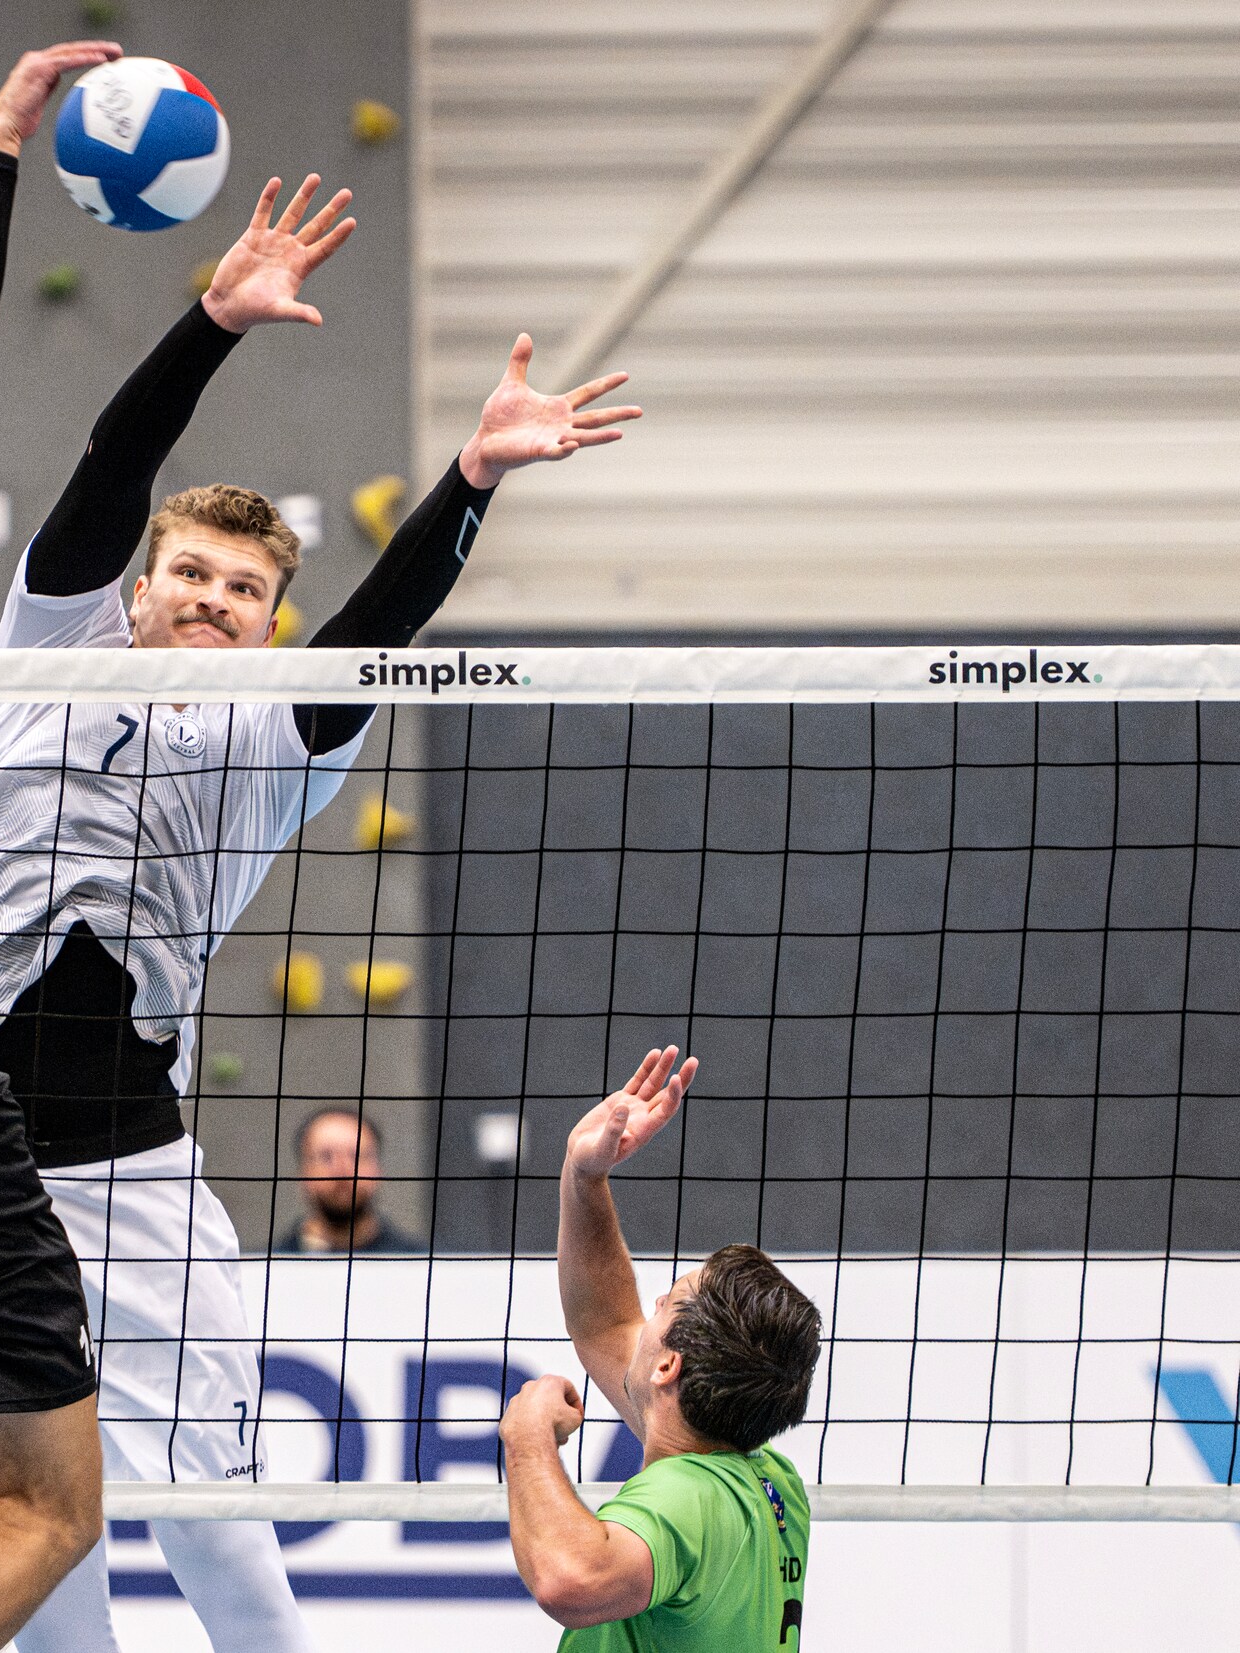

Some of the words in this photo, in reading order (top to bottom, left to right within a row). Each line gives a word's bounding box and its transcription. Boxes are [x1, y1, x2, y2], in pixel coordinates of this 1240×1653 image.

[358, 650, 531, 695] simplex.
[928, 648, 1103, 693] simplex.
[101, 713, 139, 773] 7
[233, 1400, 248, 1446] 7
